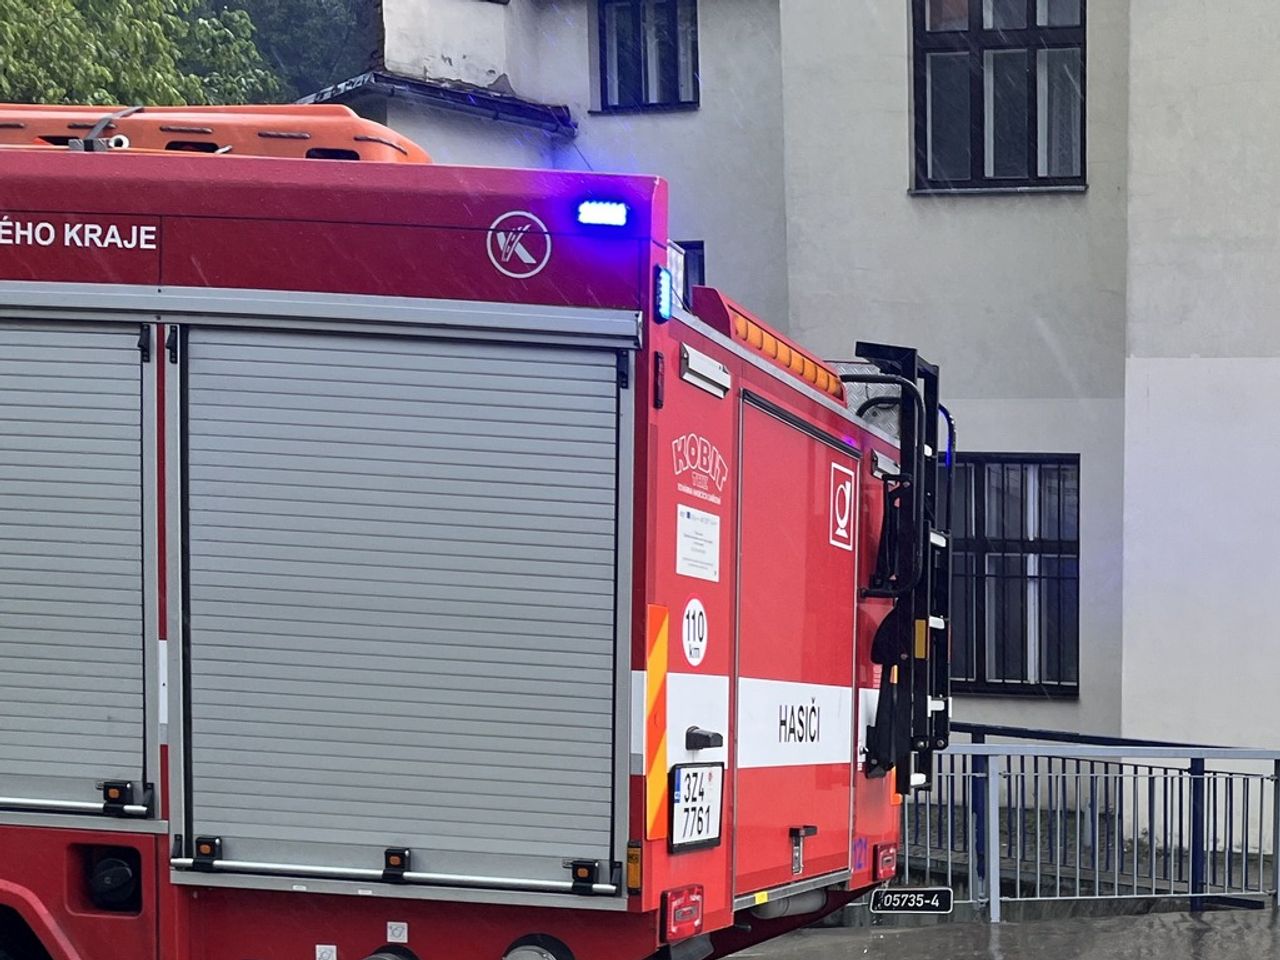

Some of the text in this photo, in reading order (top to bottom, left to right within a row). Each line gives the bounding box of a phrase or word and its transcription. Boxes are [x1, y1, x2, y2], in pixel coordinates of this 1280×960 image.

[64, 223, 157, 249] KRAJE
[672, 433, 728, 491] KOBIT
[686, 610, 705, 643] 110
[688, 644, 700, 658] km
[778, 696, 821, 743] HASIČI
[684, 772, 705, 803] 3Z4
[683, 805, 711, 838] 7761
[883, 893, 940, 908] 05735-4
